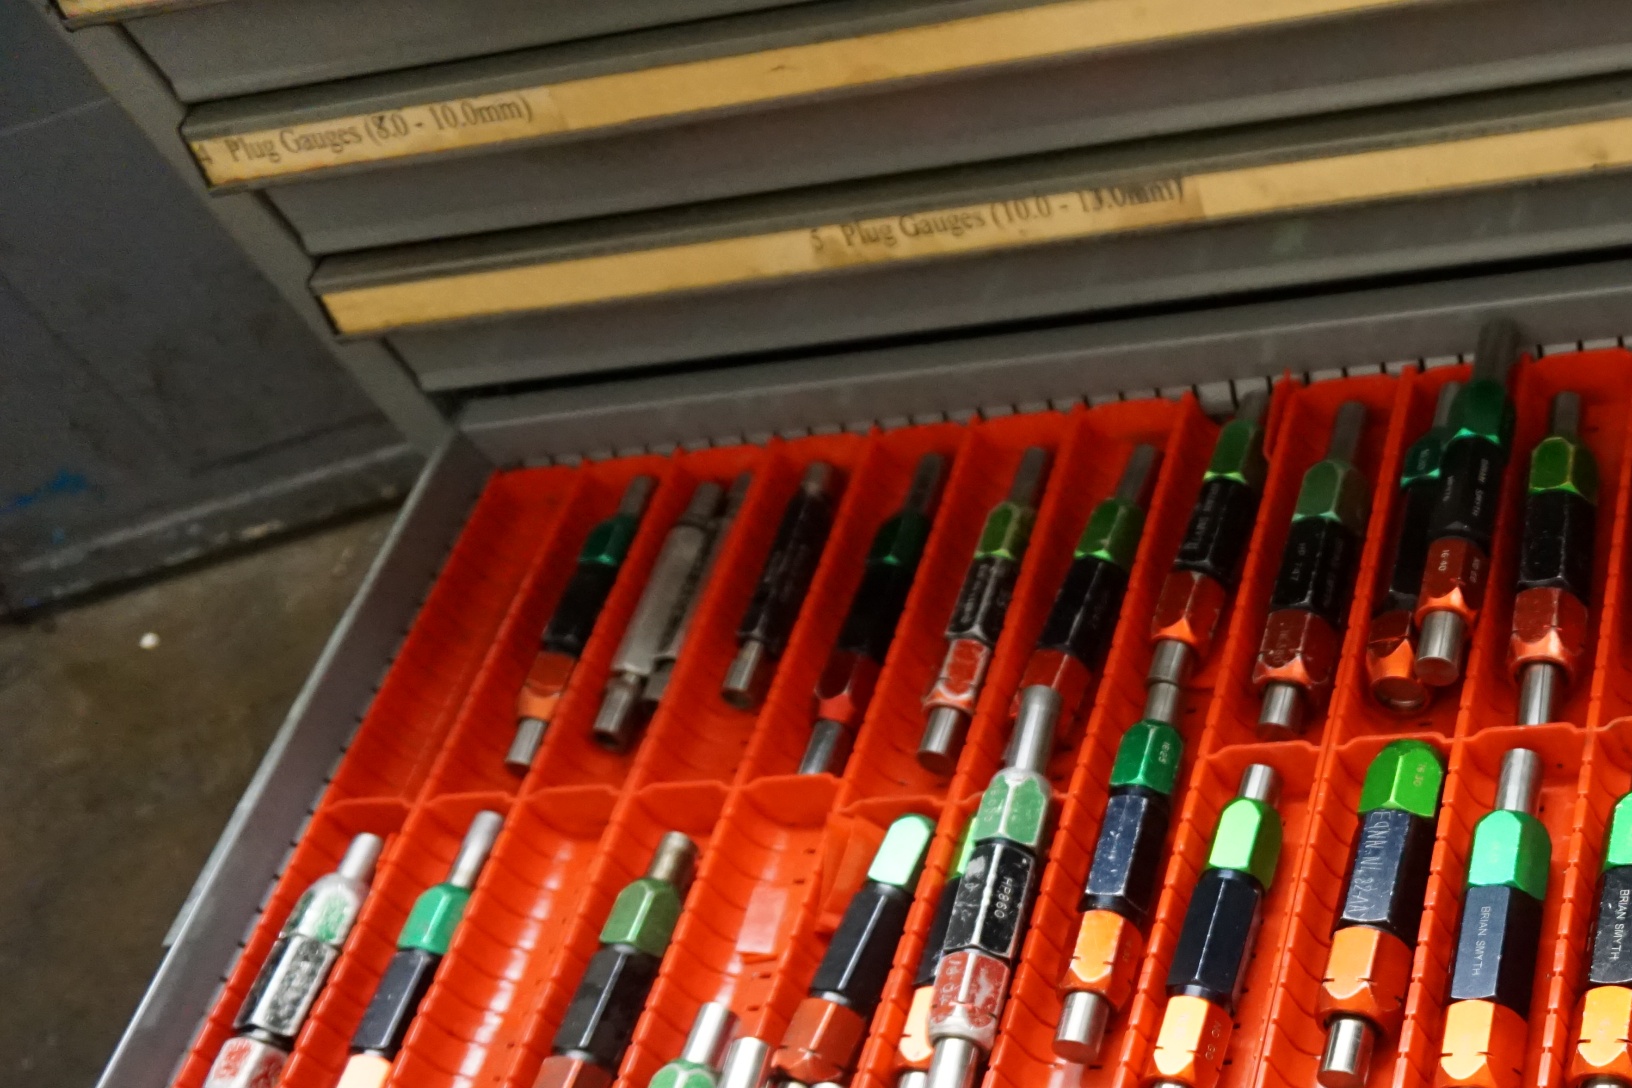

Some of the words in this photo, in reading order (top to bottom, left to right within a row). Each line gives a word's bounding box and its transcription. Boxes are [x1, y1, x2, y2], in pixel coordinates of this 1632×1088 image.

[224, 137, 282, 164] Plug
[279, 126, 363, 154] Gauges
[841, 223, 898, 248] Plug
[899, 210, 986, 238] Gauges
[993, 876, 1013, 919] HP860
[1616, 889, 1630, 921] BRIAN
[1477, 905, 1491, 937] BRIAN
[1471, 940, 1486, 977] SMYTH
[1608, 922, 1625, 961] SMYTH
